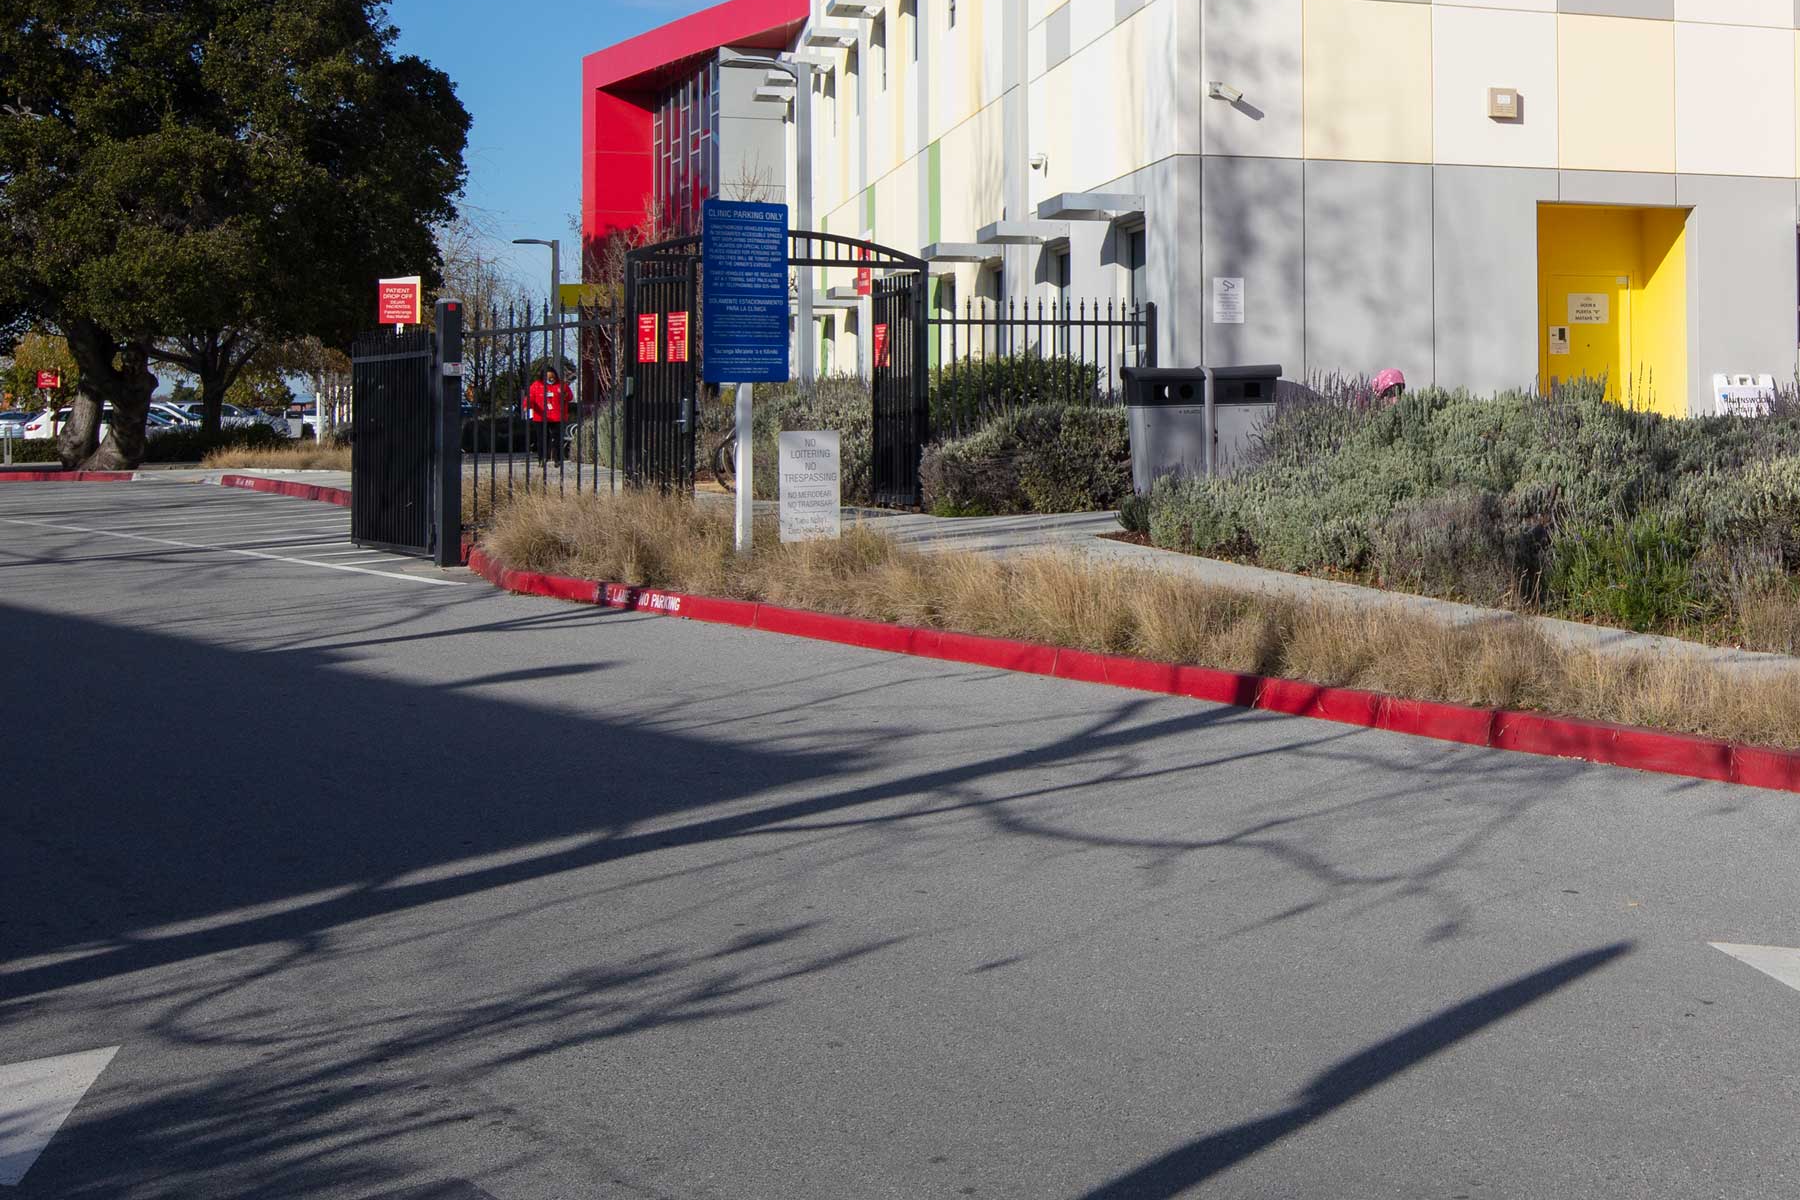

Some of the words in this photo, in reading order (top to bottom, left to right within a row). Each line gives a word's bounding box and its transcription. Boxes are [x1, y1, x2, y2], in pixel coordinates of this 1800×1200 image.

[708, 209, 732, 218] CLINIC
[734, 210, 764, 220] PARKING
[765, 212, 784, 221] ONLY
[804, 438, 816, 448] NO
[790, 449, 832, 459] LOITERING
[805, 462, 817, 471] NO
[784, 473, 837, 483] TRESPASSING
[638, 592, 650, 606] NO
[651, 594, 680, 611] PARKING
